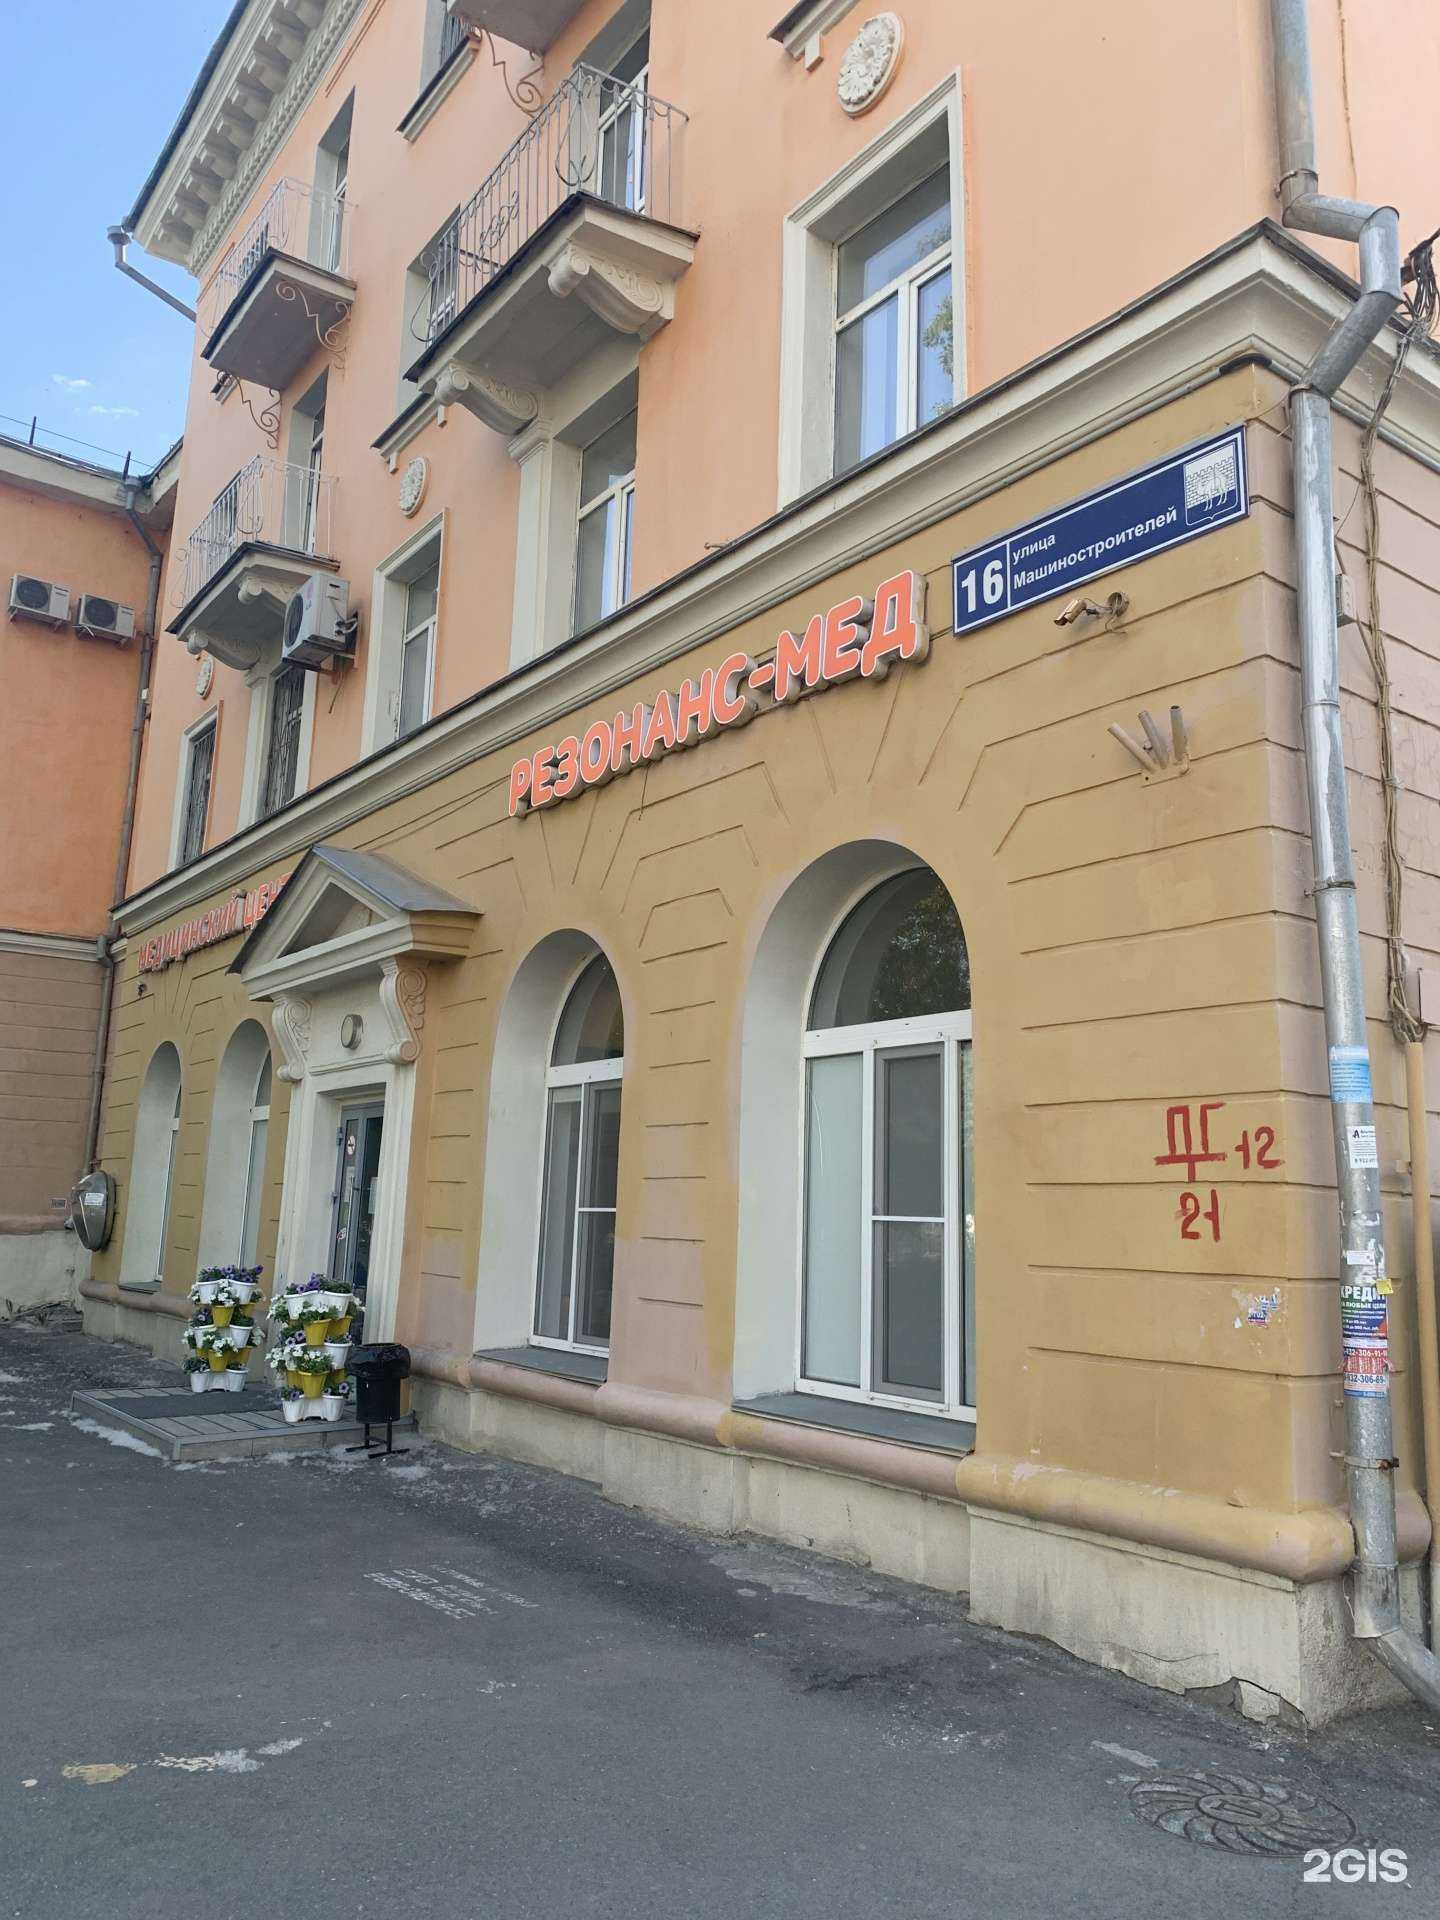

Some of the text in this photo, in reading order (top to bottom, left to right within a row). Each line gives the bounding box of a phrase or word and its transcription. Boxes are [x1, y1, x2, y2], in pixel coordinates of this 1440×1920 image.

[1012, 532, 1056, 564] улица
[1013, 506, 1178, 589] Машиностроителей
[961, 559, 1004, 613] 16
[508, 570, 918, 816] РЕЗОНАНС-МЕД
[138, 872, 293, 972] МЕДИЦИНСКИЙ ЦЕН
[1235, 1125, 1285, 1169] 12
[1179, 1189, 1221, 1242] 21
[1341, 1285, 1386, 1302] КРЕДИ
